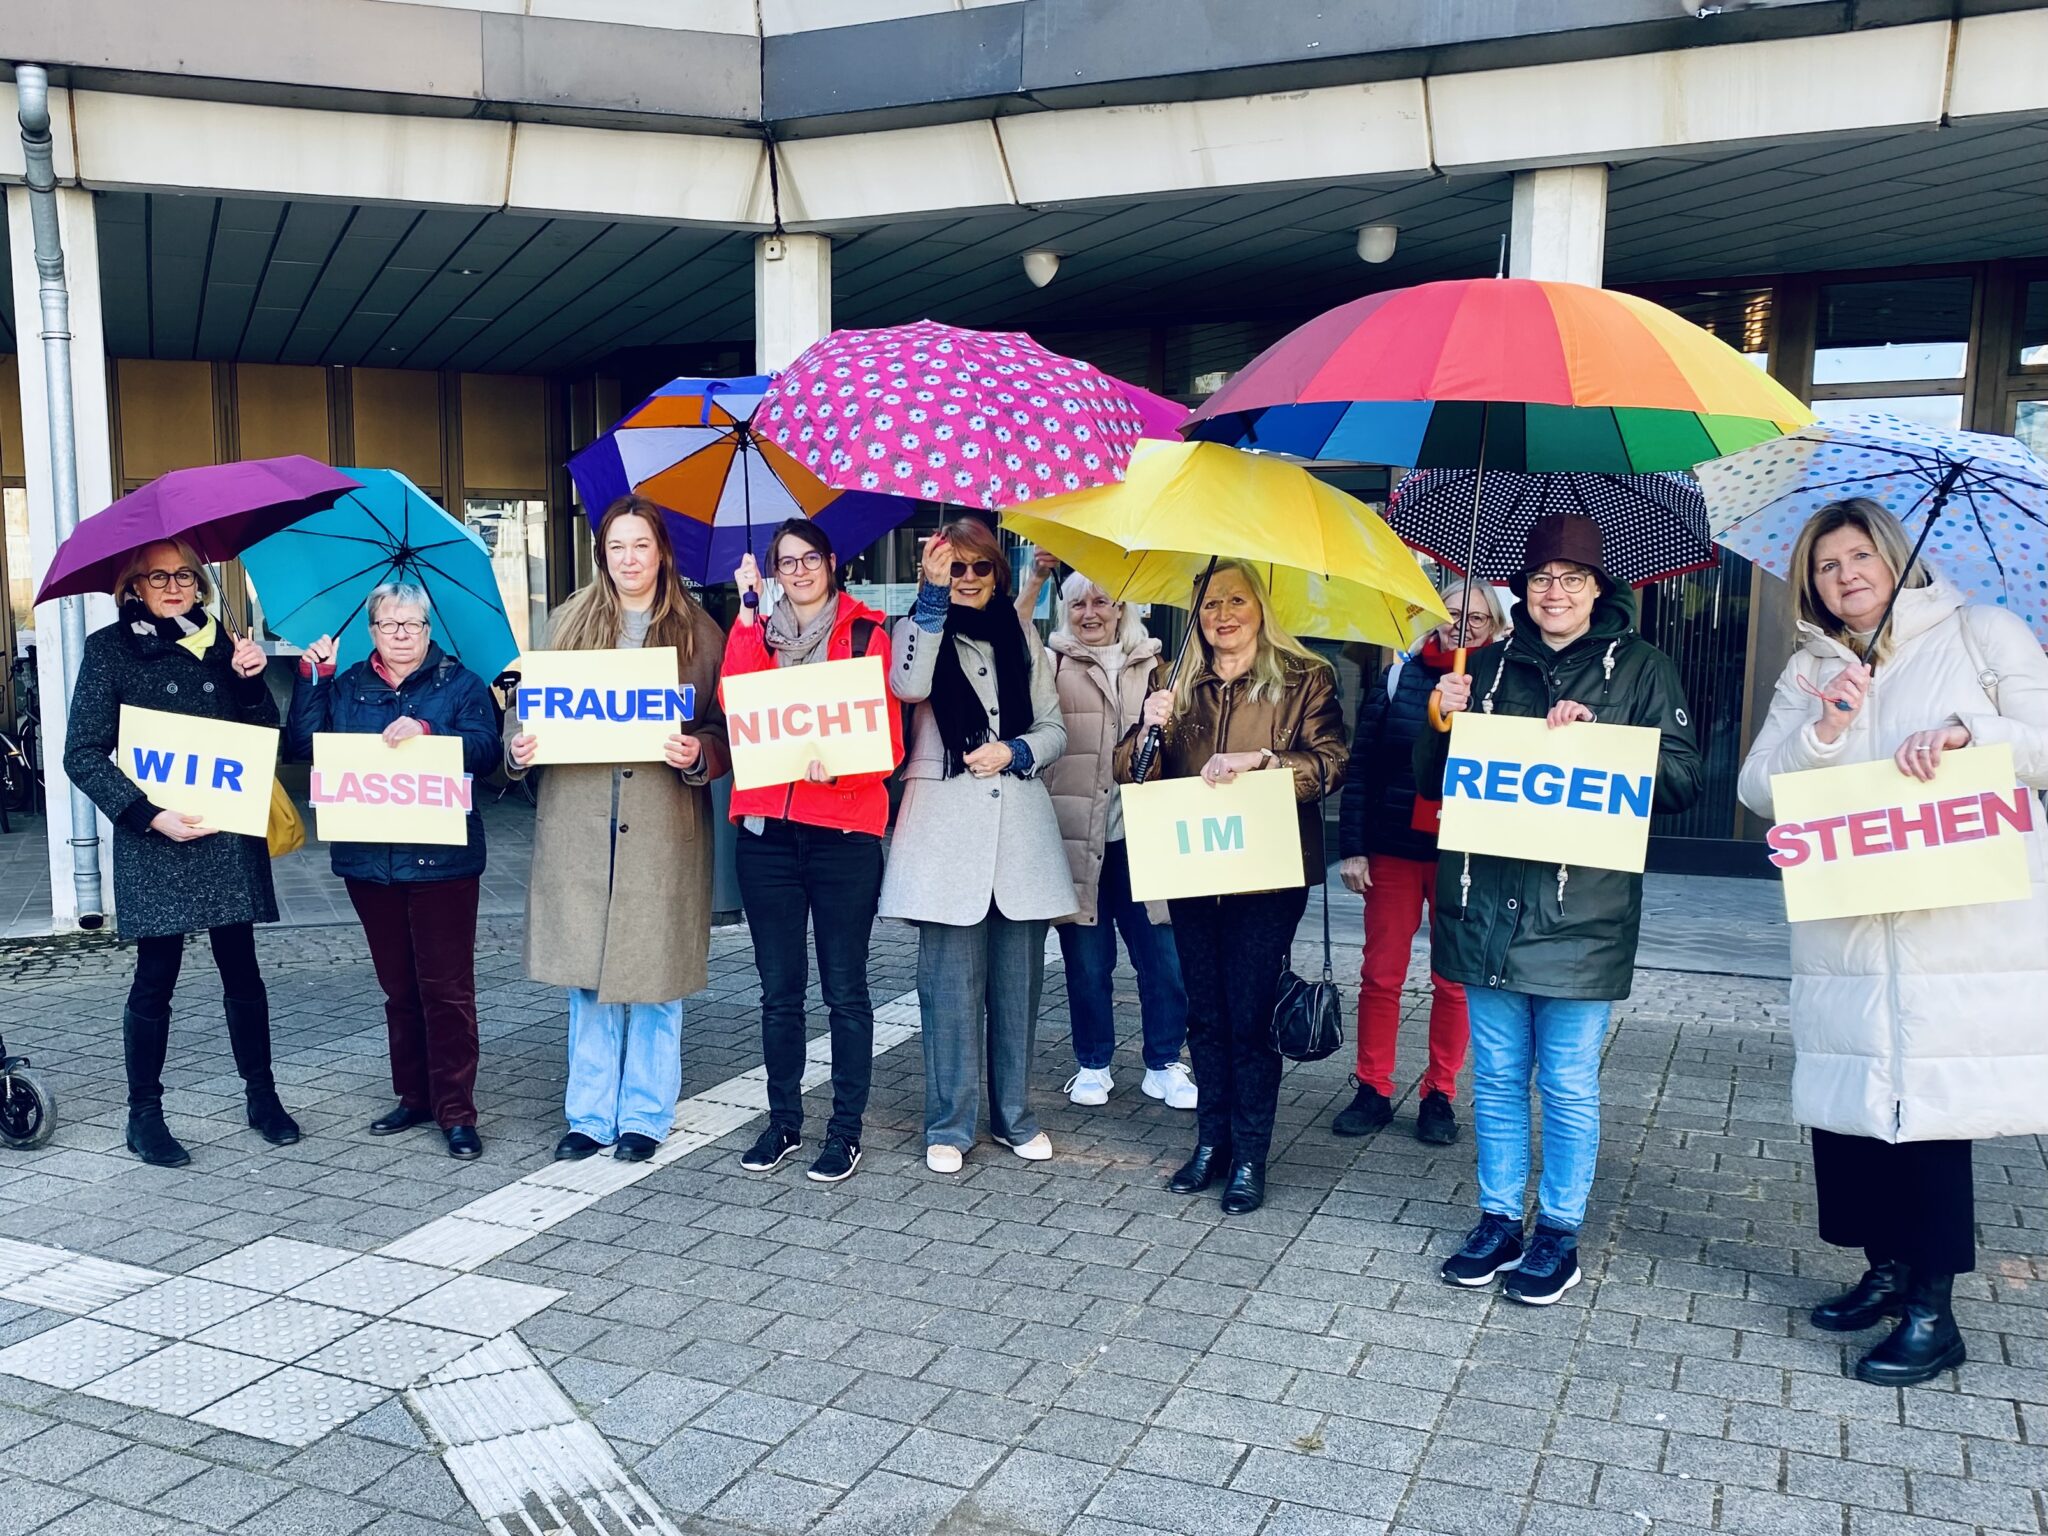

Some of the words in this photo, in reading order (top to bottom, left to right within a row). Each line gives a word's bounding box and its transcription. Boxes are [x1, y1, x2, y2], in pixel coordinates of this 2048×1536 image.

[518, 687, 694, 722] FRAUEN
[729, 698, 884, 746] NICHT
[133, 747, 244, 792] WIR
[312, 772, 471, 809] LASSEN
[1444, 757, 1652, 817] REGEN
[1176, 816, 1244, 854] IM
[1767, 788, 2034, 867] STEHEN
